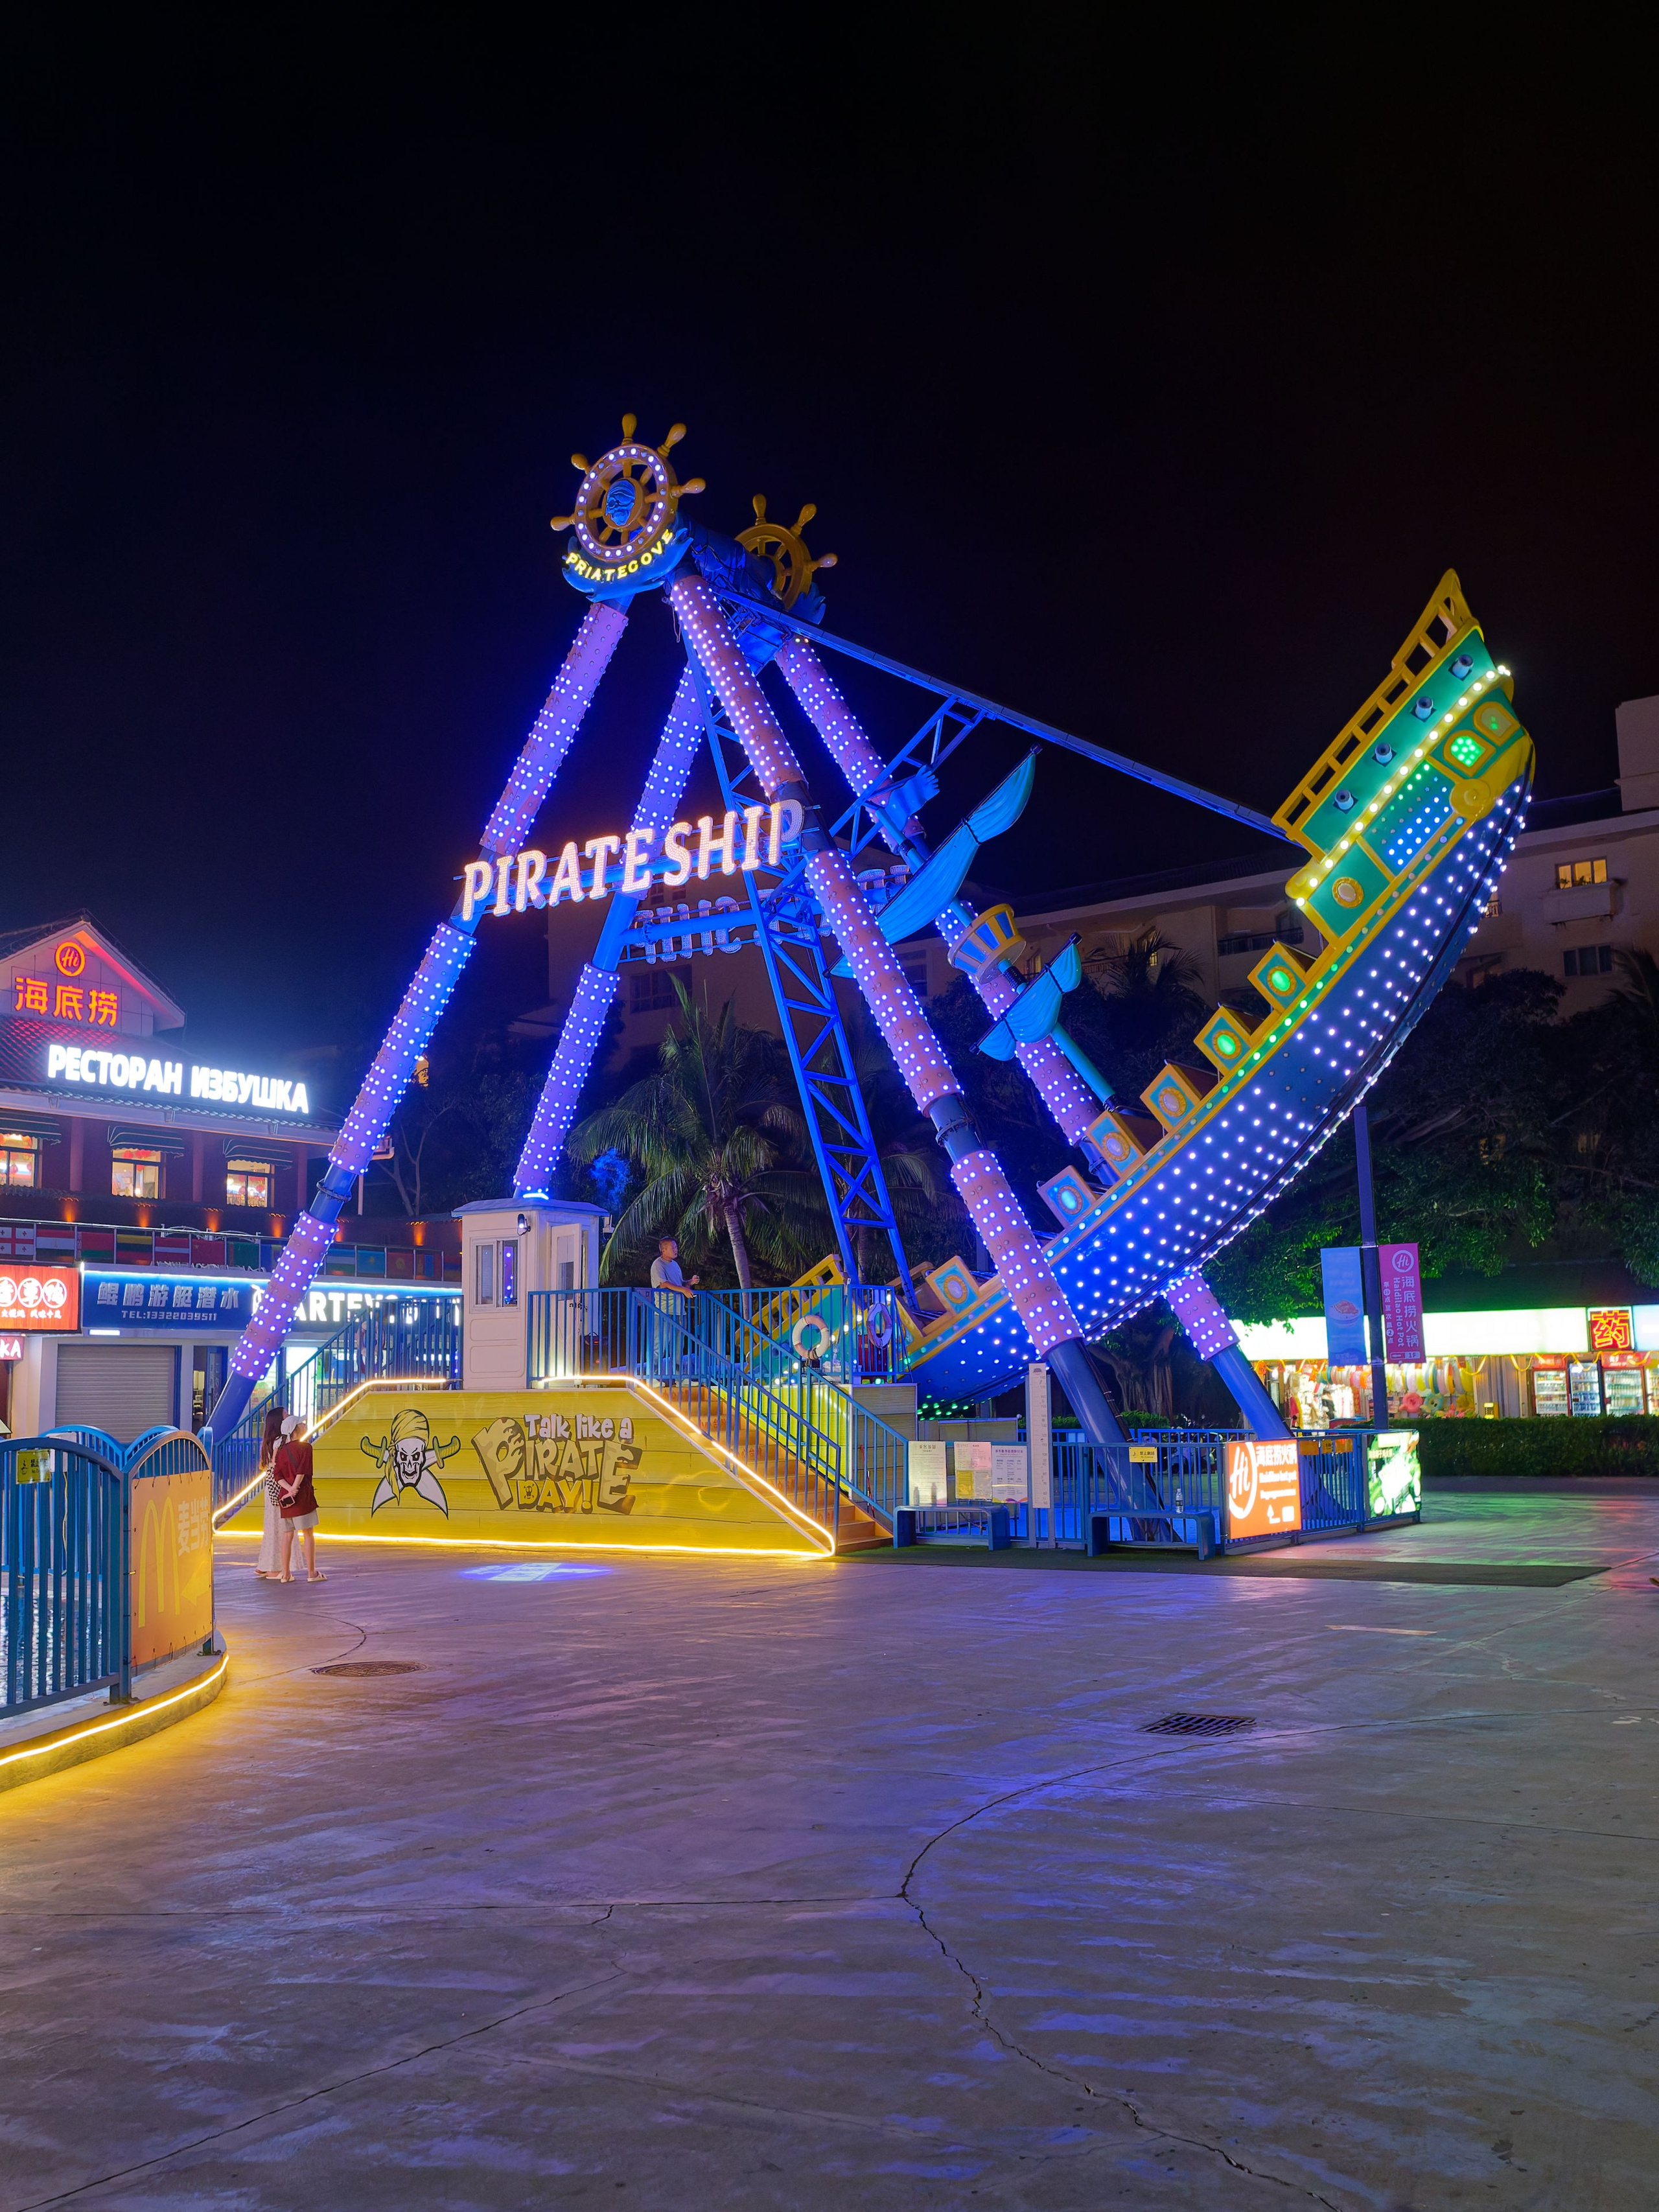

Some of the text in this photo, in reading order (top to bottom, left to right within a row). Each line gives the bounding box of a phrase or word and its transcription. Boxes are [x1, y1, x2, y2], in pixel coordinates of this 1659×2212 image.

[462, 798, 806, 922] PIRATE SHIP
[15, 977, 118, 1027] 海底捞
[47, 1043, 310, 1114] РЕСТОРАН ИЗБУШКА
[97, 1281, 240, 1310] 鲲鹏游艇潜水
[121, 1310, 218, 1321] TEL:13322039511
[1393, 1277, 1402, 1314] Haidilao
[1402, 1275, 1419, 1348] 海底捞火锅
[1395, 1315, 1404, 1331] Hot
[1591, 1309, 1630, 1349] 药
[524, 1414, 634, 1441] Talk like a
[471, 1417, 643, 1515] PIRATE
[516, 1478, 594, 1515] DAY!
[178, 1496, 209, 1557] 麦当劳
